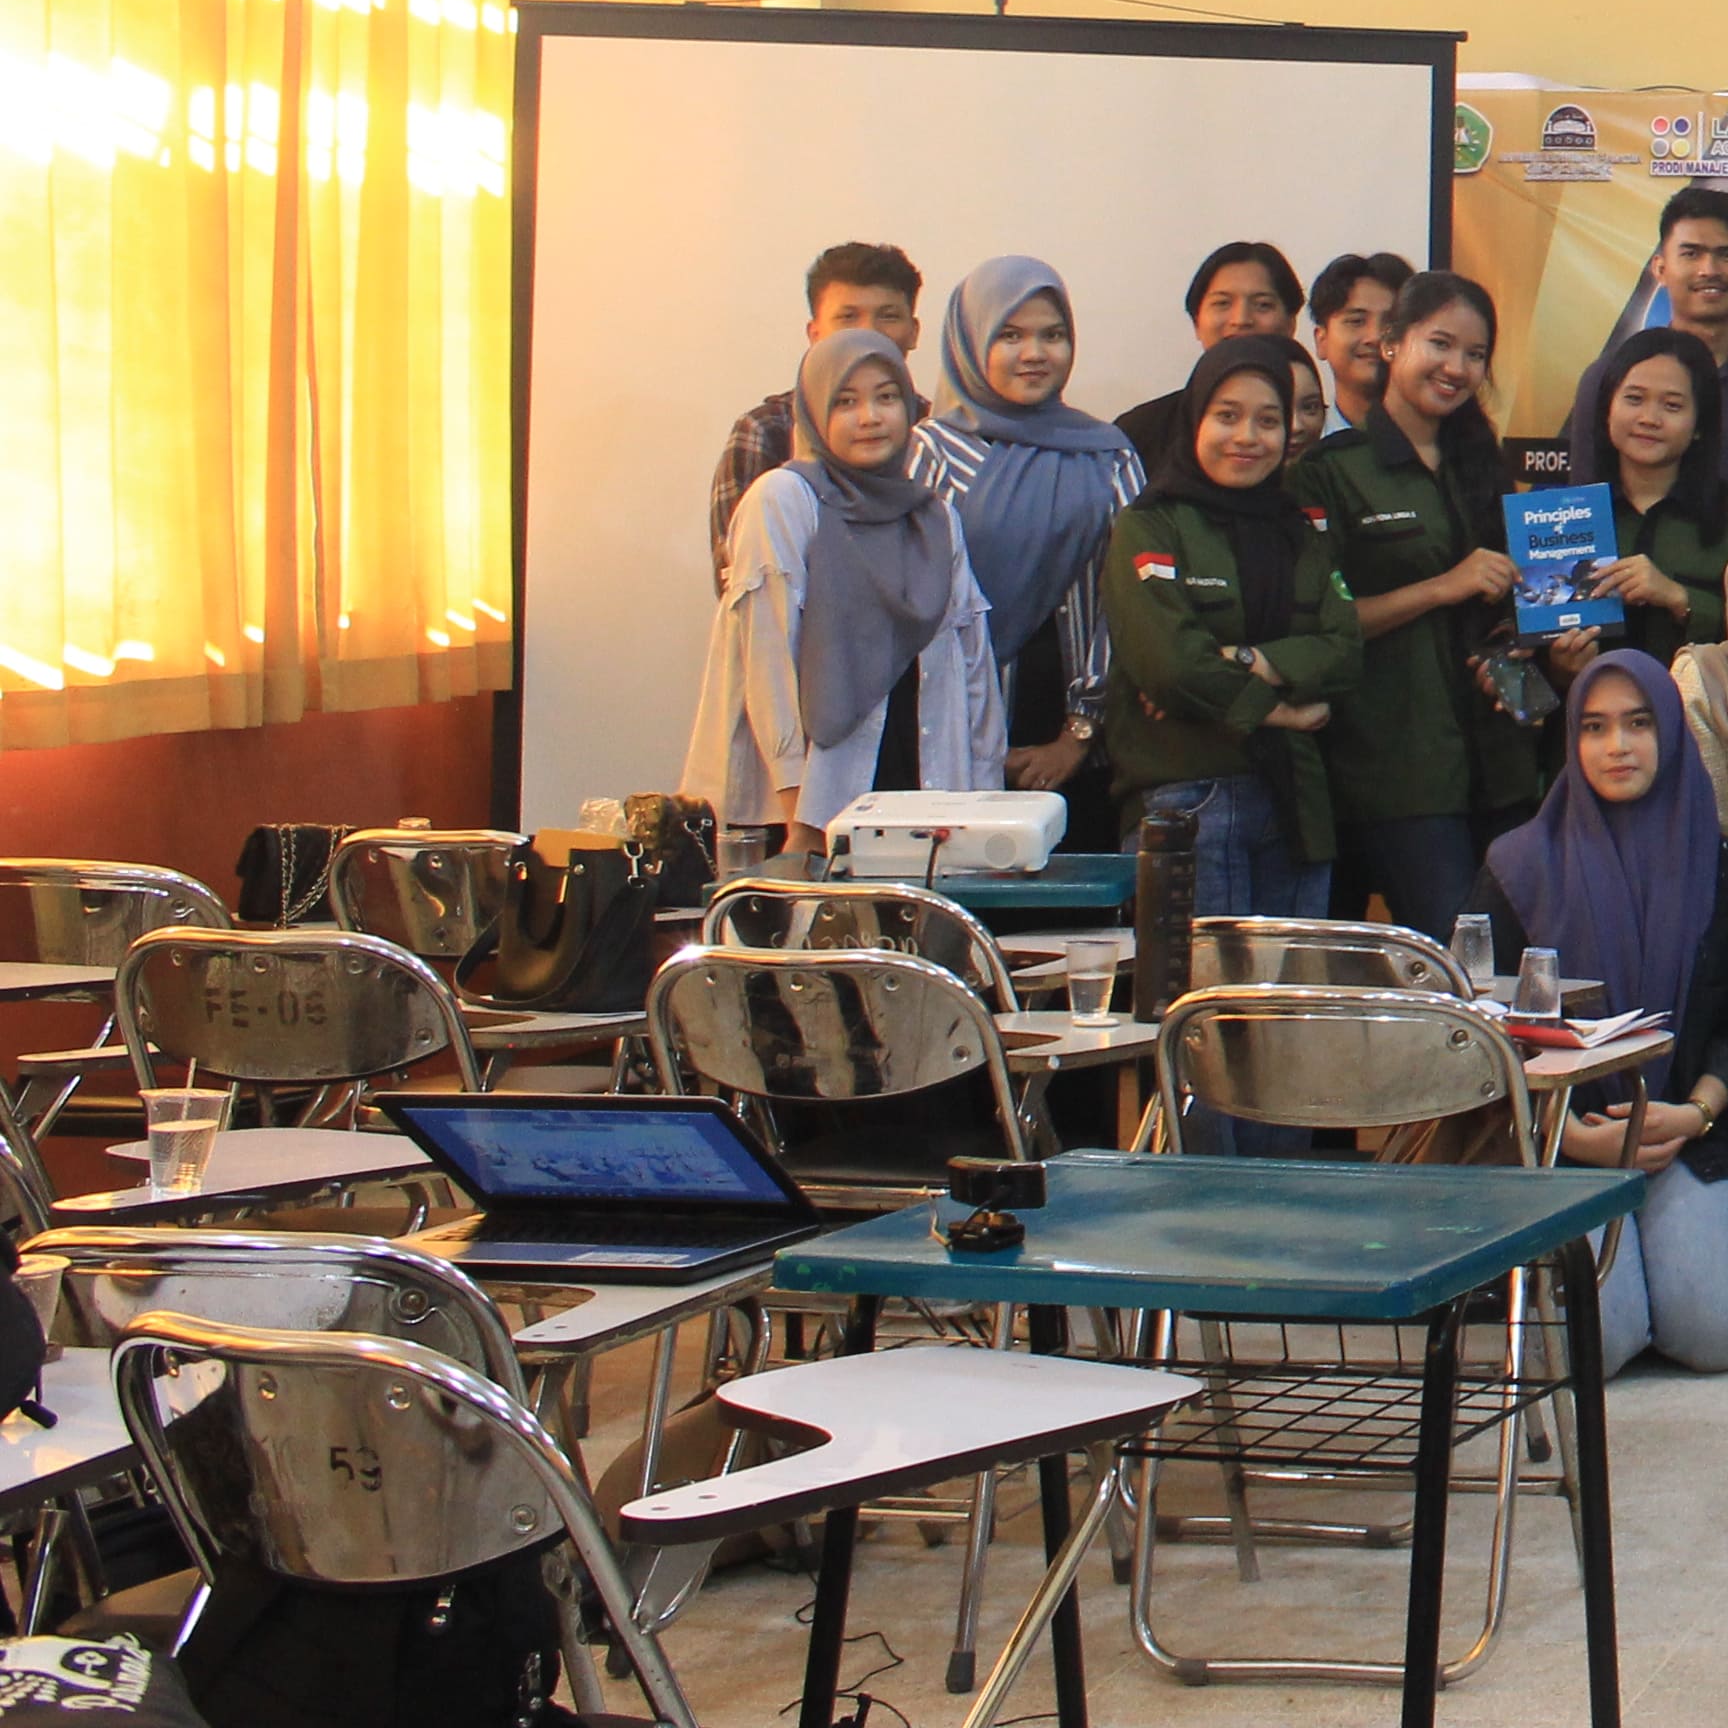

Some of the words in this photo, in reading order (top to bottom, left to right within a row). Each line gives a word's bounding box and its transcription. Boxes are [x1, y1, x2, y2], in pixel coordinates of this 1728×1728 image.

[1652, 161, 1683, 174] PRODI
[1524, 450, 1572, 472] PROF.
[1524, 505, 1593, 526] Principles
[1528, 530, 1595, 550] Business
[1528, 544, 1597, 561] Management
